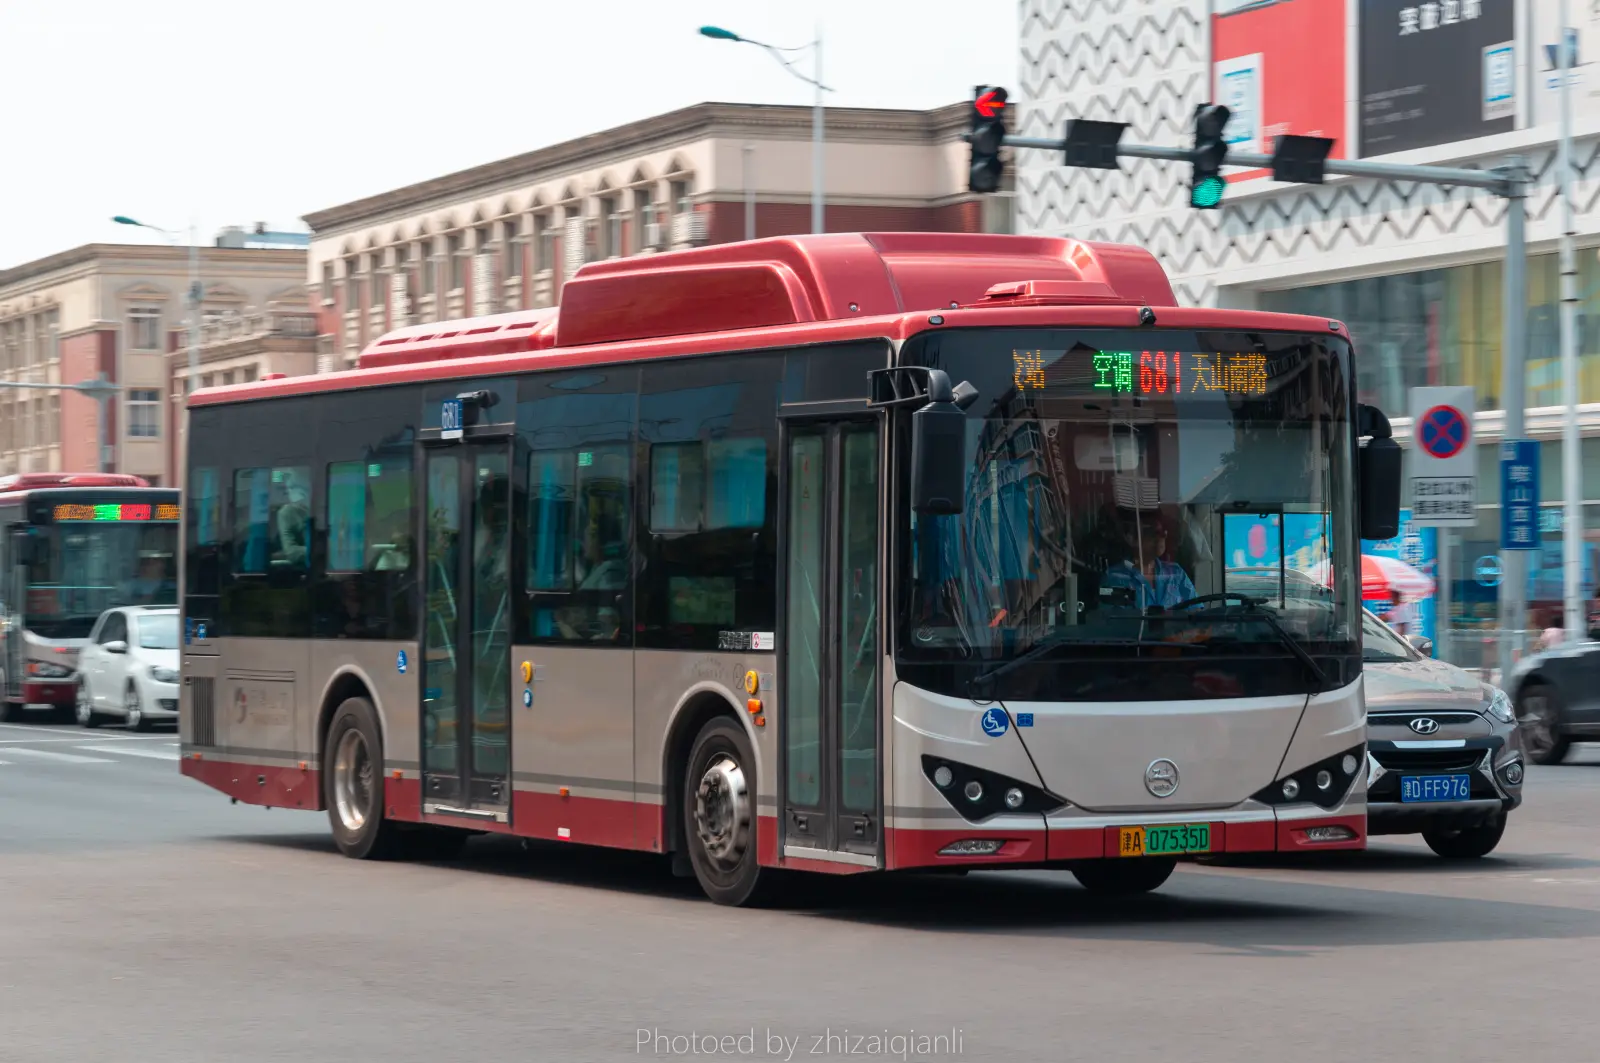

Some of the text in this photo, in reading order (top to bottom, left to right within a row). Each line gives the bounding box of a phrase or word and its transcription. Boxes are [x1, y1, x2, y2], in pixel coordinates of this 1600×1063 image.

[1092, 350, 1132, 393] 空调
[1139, 351, 1181, 393] 681
[1190, 352, 1268, 394] 天山南路
[441, 402, 459, 429] 681
